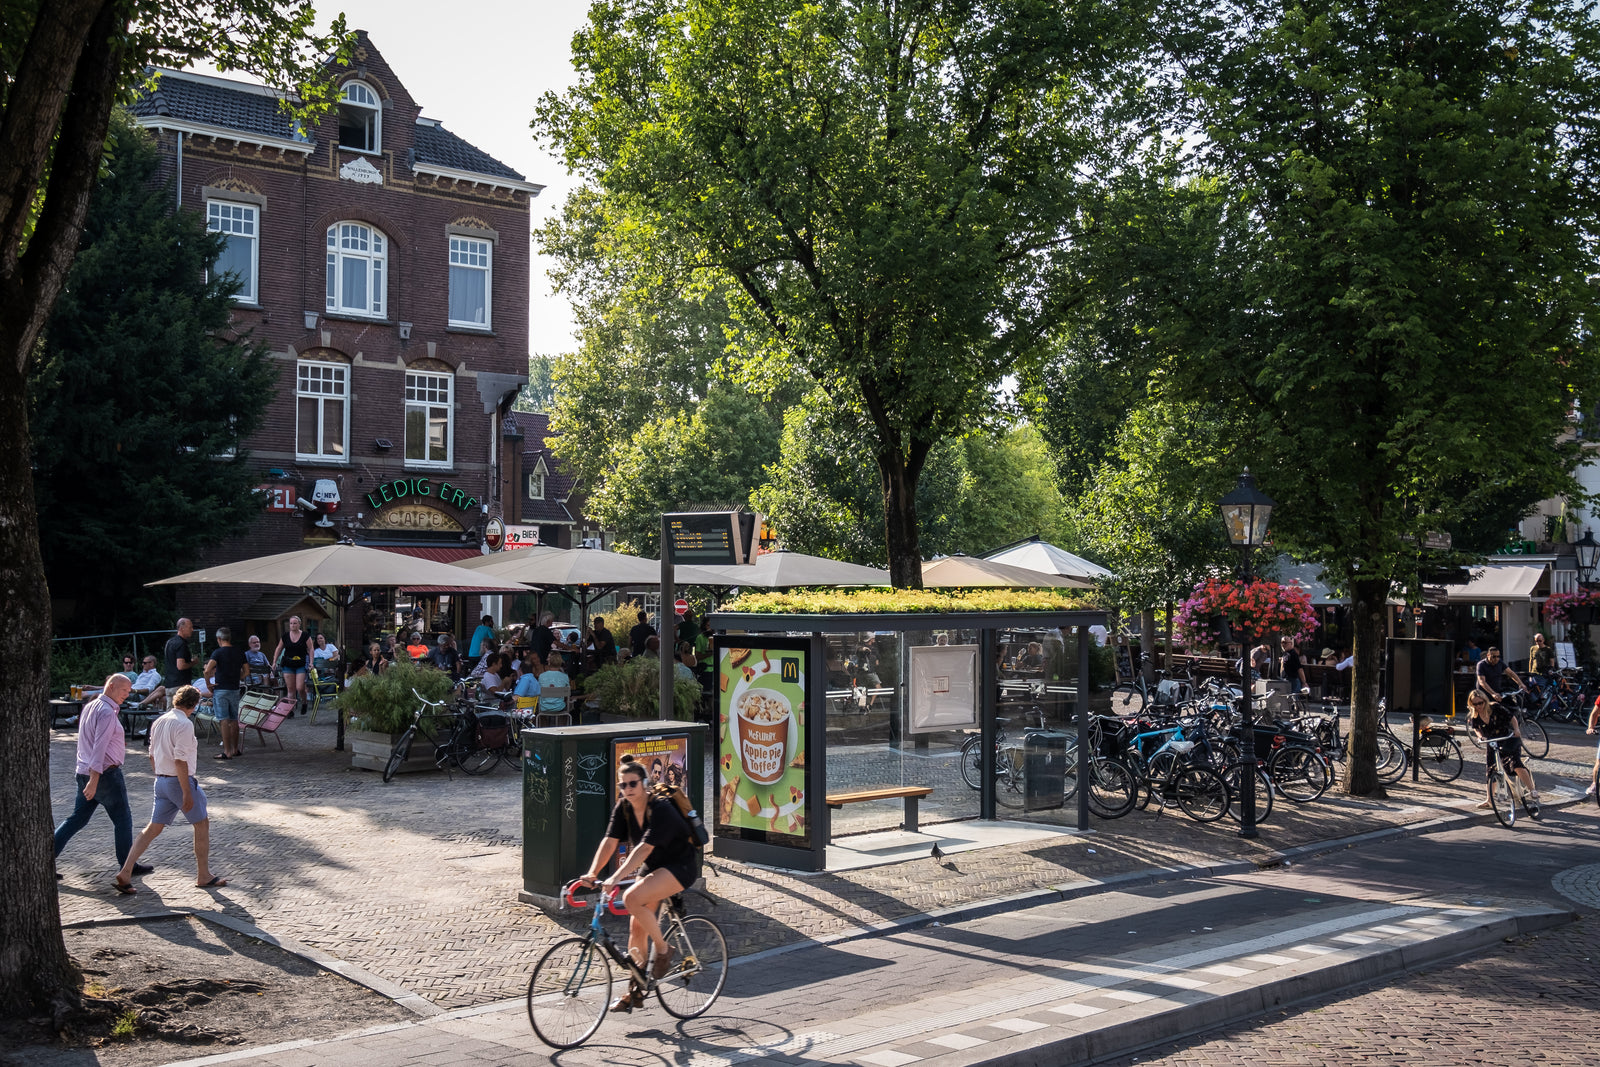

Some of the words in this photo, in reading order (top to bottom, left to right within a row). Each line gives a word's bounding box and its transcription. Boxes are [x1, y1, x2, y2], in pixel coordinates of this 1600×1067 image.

[368, 478, 430, 508] LEDIG
[440, 482, 477, 510] ERF
[522, 530, 537, 538] BIER
[745, 743, 768, 760] Apple
[750, 758, 777, 773] Toffee
